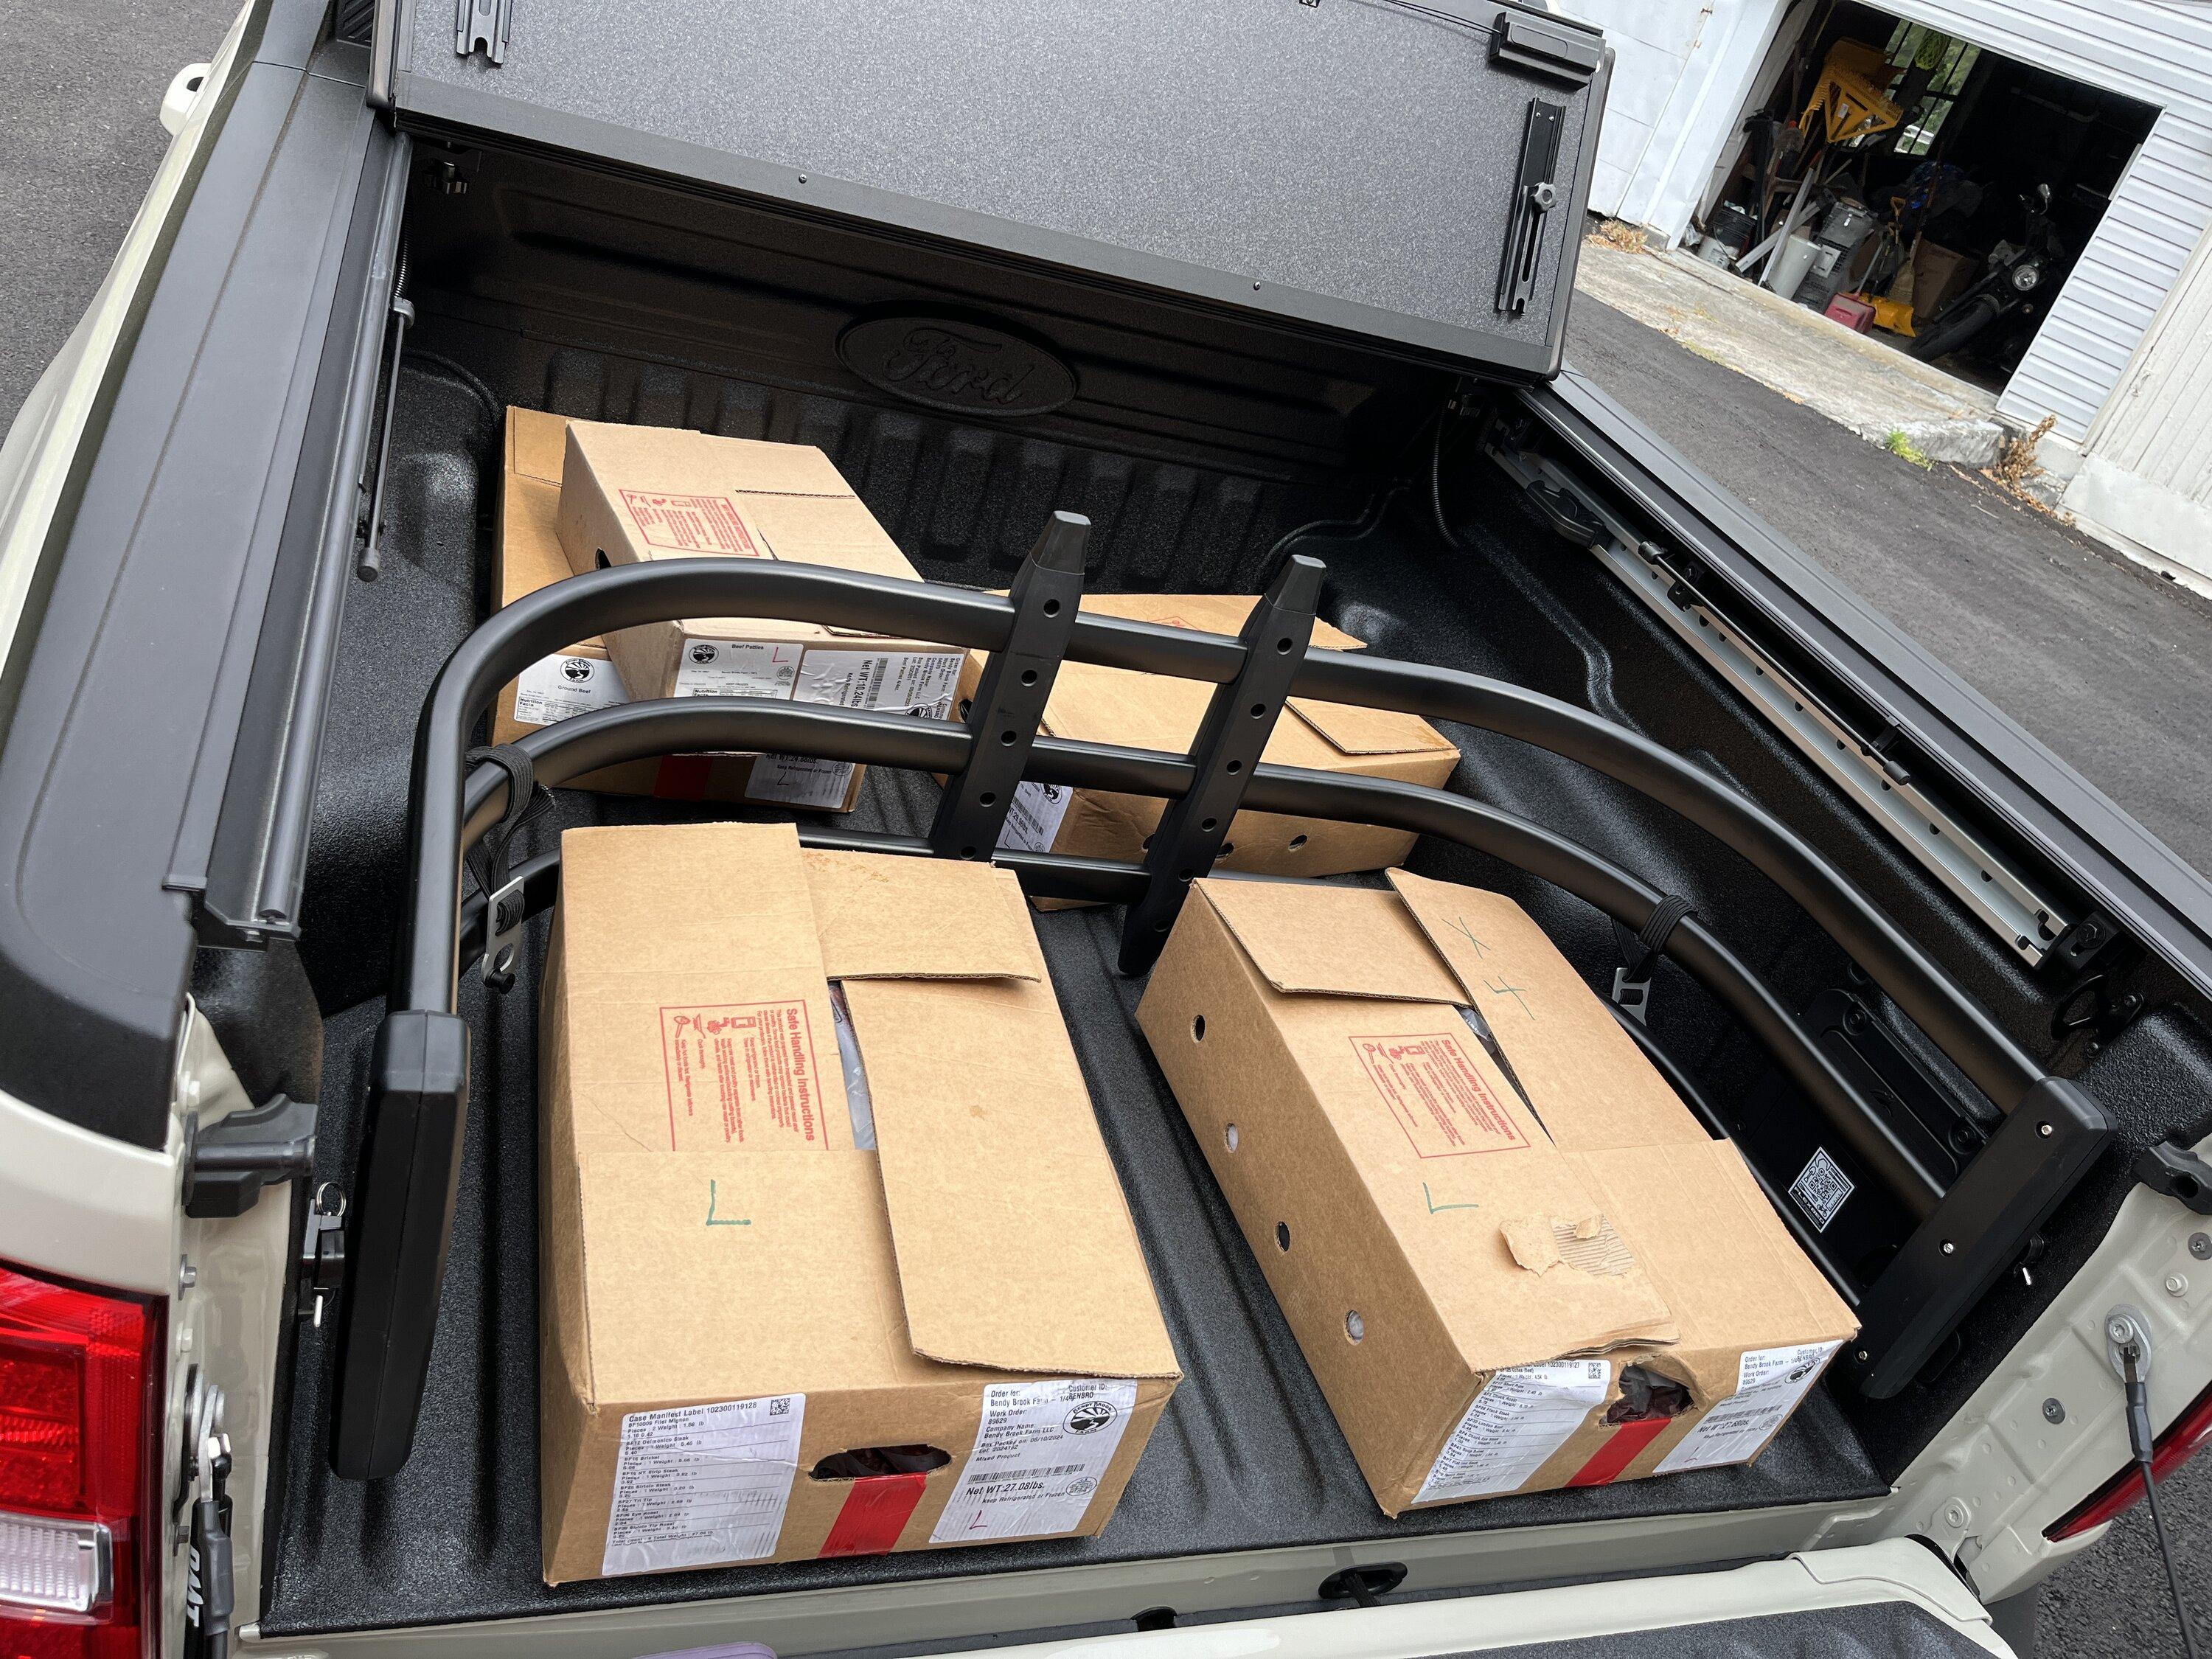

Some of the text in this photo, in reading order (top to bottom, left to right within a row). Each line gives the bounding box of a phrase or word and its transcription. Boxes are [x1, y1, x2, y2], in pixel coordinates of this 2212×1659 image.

[883, 327, 1034, 405] Ford
[861, 660, 872, 669] Net
[787, 1009, 815, 1141] Safe Handling Instructions
[1441, 1039, 1516, 1141] Safe Handling Instructions
[706, 1179, 751, 1226] L
[990, 1399, 1009, 1408] Bendy
[650, 1411, 681, 1420] Manifest
[706, 1402, 757, 1413] 102300119128
[987, 1425, 1015, 1433] Company
[966, 1487, 984, 1495] Net
[999, 1494, 1035, 1503] Refrigerated
